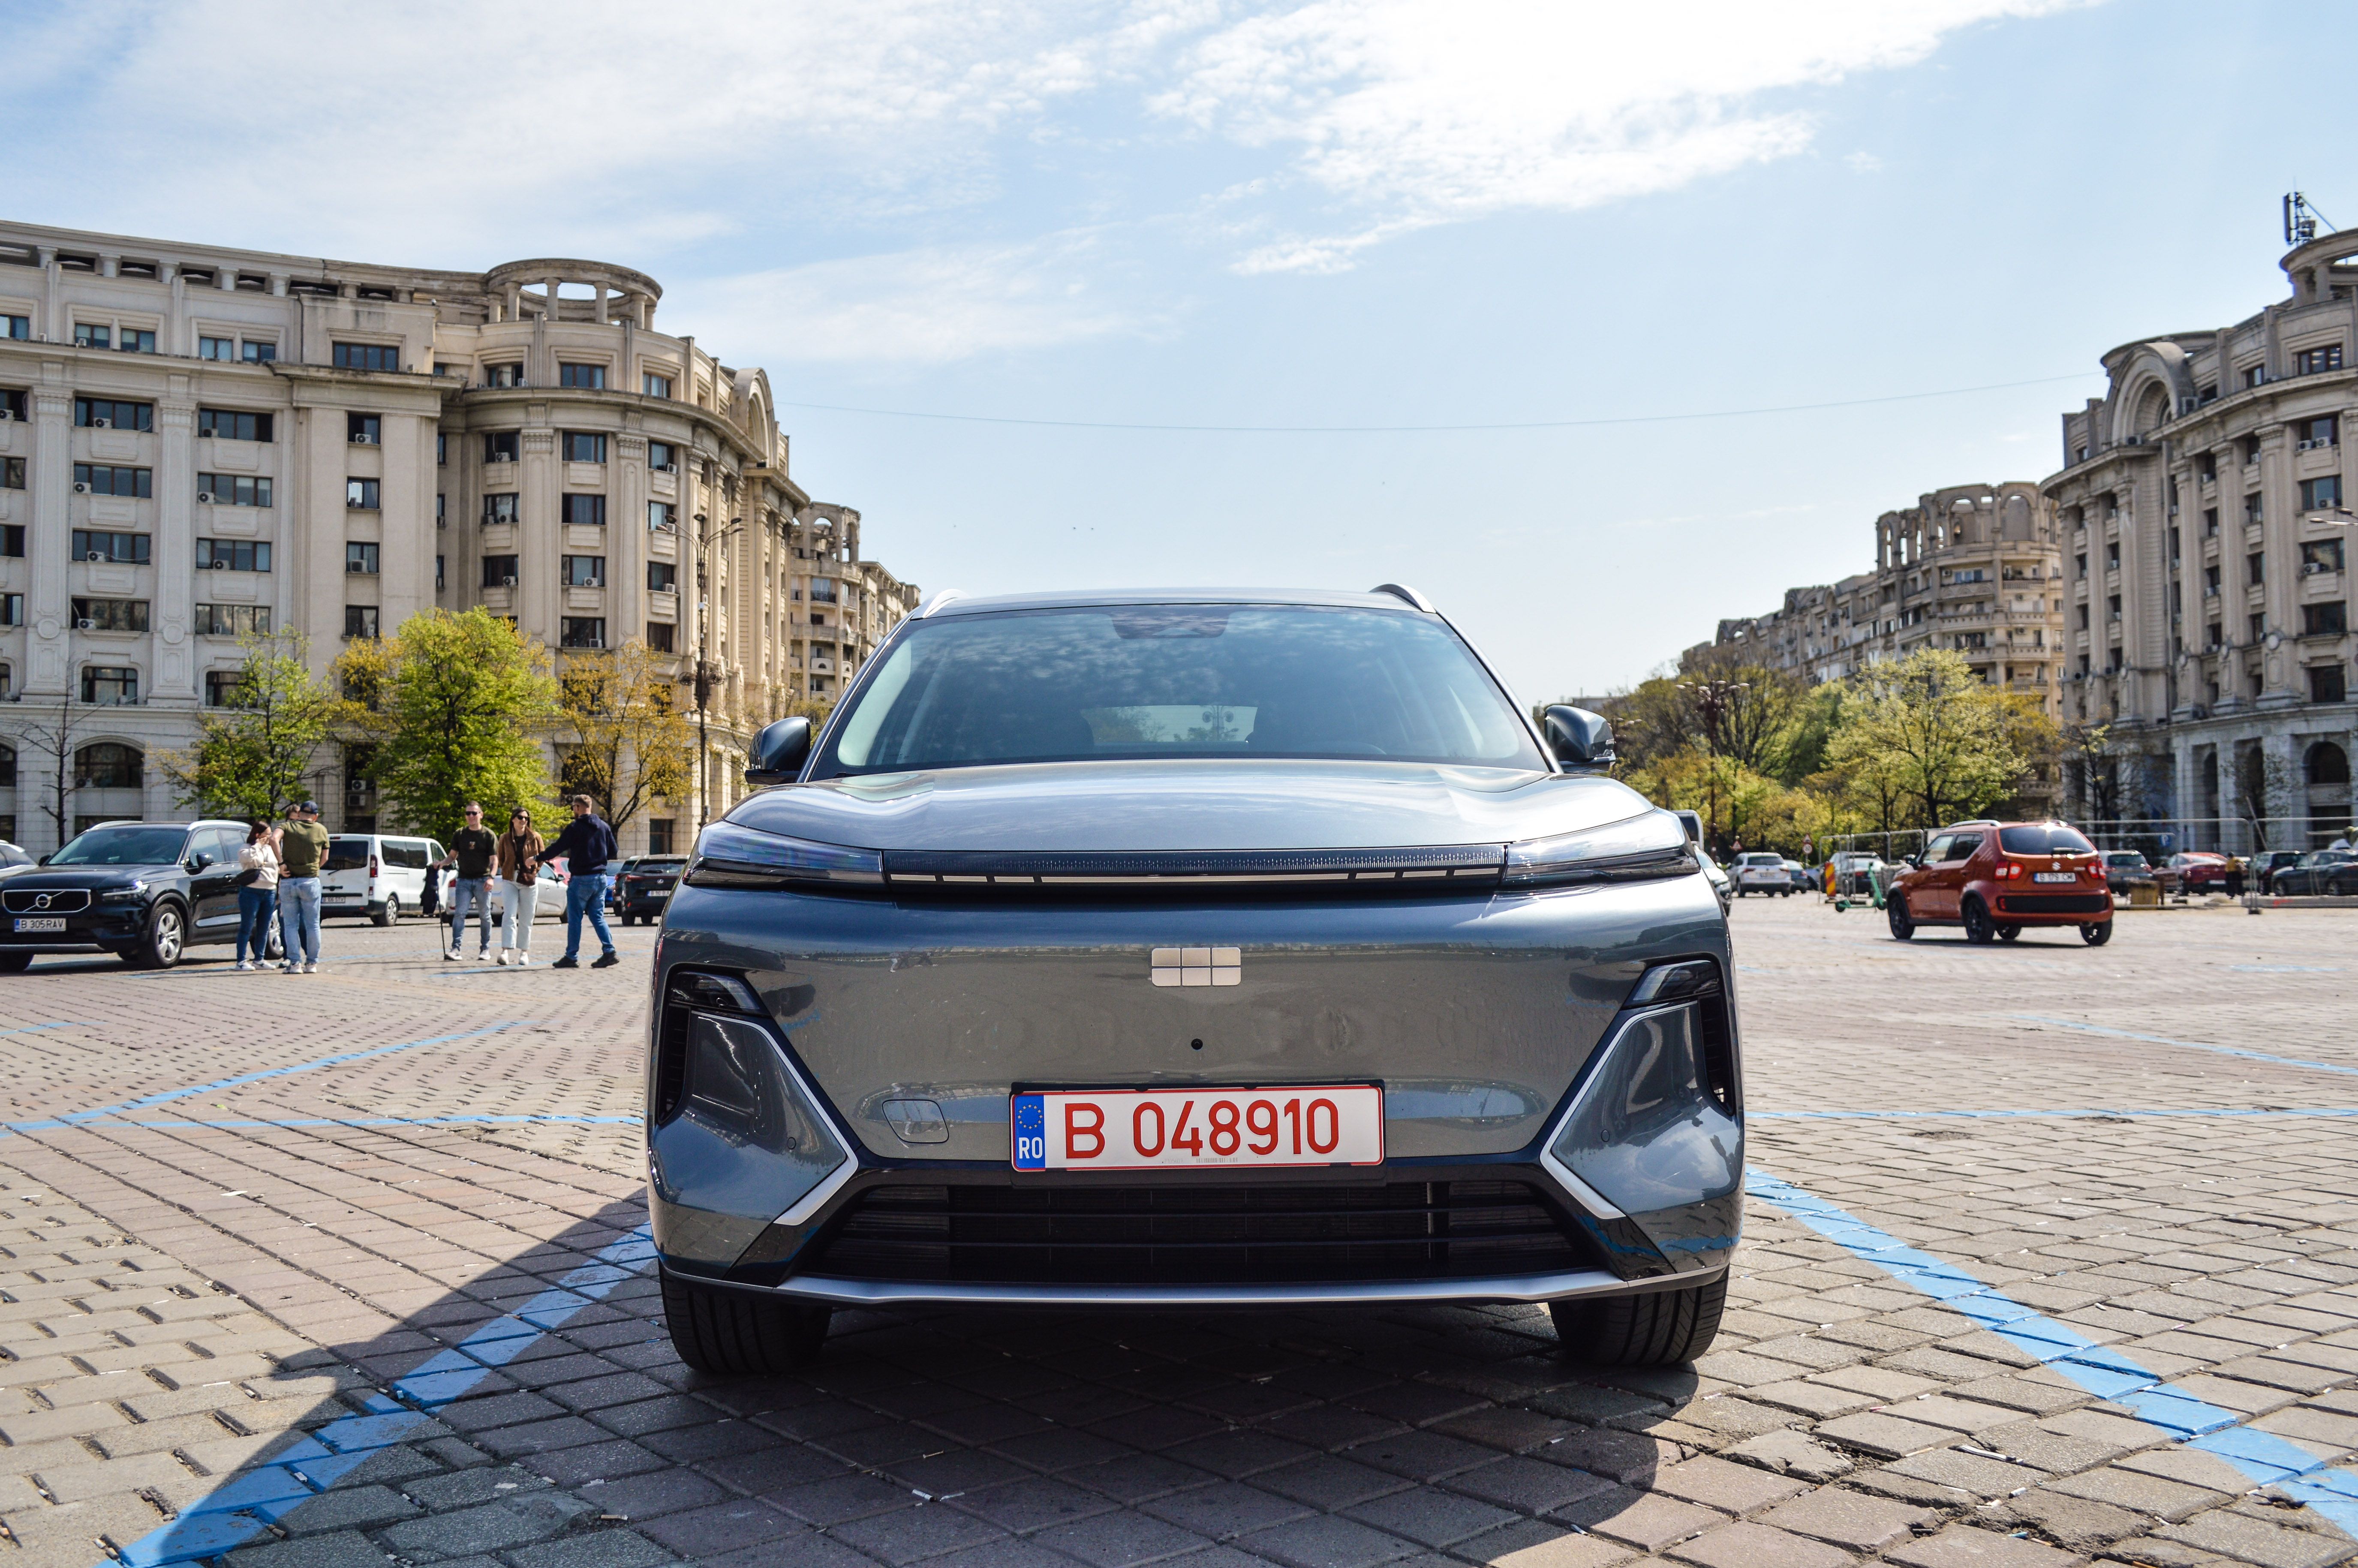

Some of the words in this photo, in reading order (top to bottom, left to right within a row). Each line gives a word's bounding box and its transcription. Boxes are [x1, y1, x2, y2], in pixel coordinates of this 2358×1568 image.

[21, 920, 27, 928] B
[1065, 1103, 1105, 1159] B
[1133, 1098, 1339, 1157] 048910
[1019, 1137, 1043, 1159] RO
